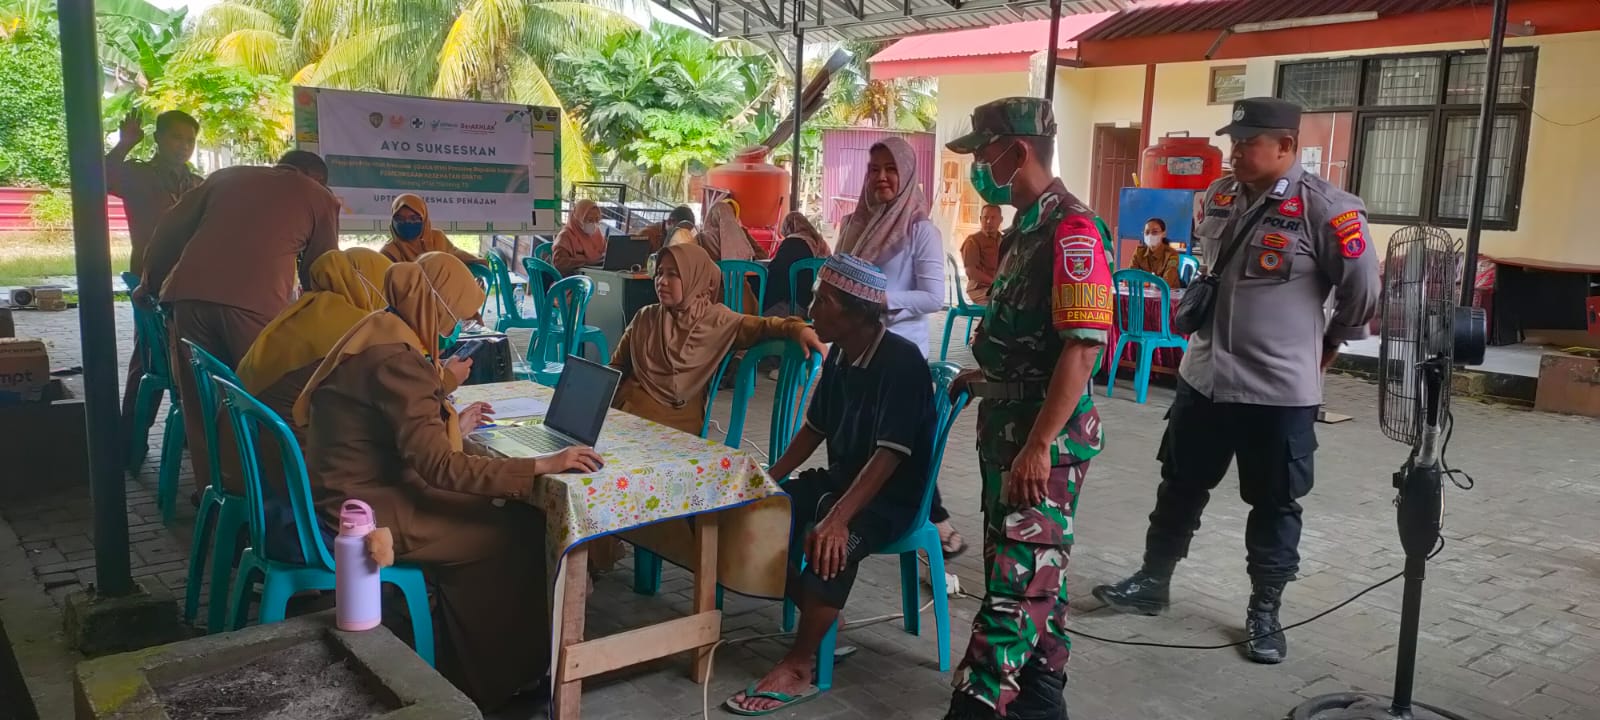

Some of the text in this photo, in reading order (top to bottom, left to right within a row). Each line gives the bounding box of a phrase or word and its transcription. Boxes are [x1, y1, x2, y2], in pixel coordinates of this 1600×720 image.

[381, 141, 496, 156] AYO SUKSESKAN
[1262, 216, 1301, 232] POLRI
[1066, 310, 1110, 321] PENAJAM
